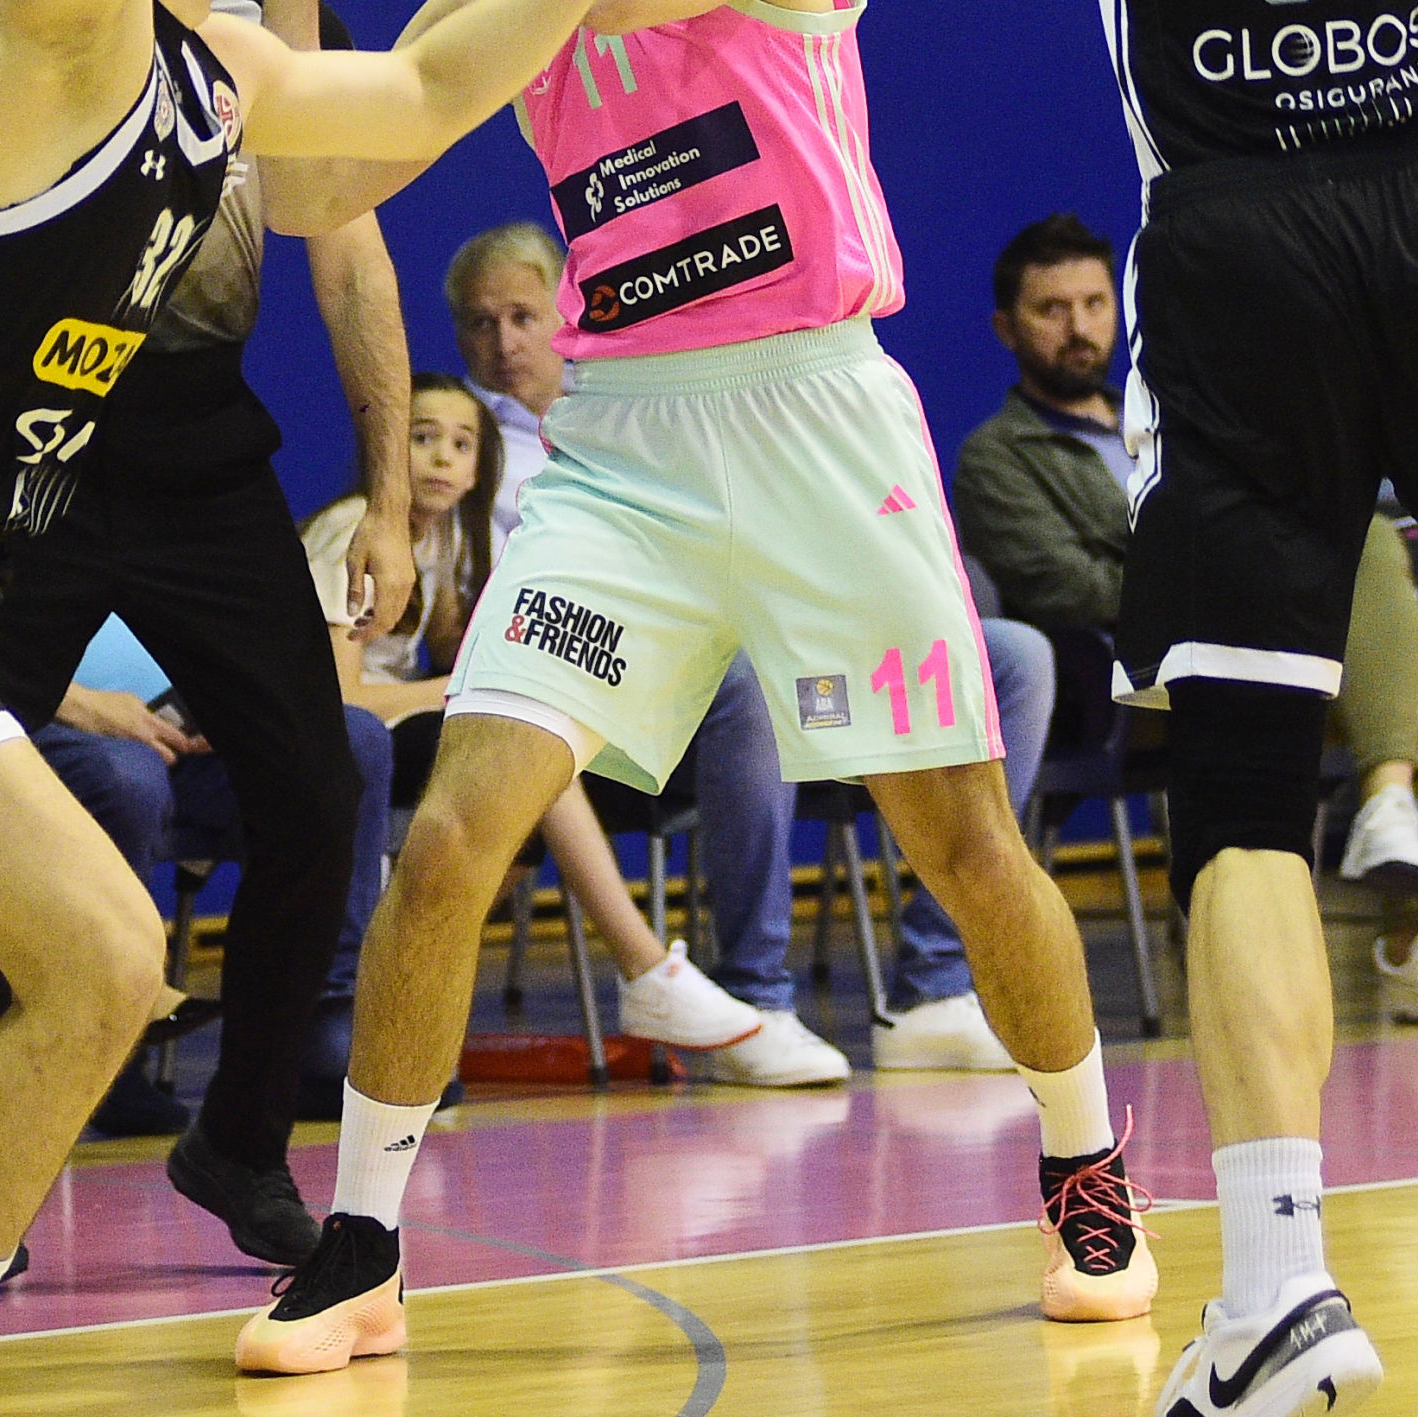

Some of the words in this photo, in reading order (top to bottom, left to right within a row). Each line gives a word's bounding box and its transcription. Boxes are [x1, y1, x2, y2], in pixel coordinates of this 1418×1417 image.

[572, 25, 638, 110] 11
[599, 140, 657, 179] Medical
[613, 177, 682, 214] Solutions
[618, 147, 701, 191] Innovation
[130, 208, 196, 309] 32
[619, 225, 782, 306] COMTRADE
[513, 587, 625, 654] FASHION
[870, 638, 956, 736] 11
